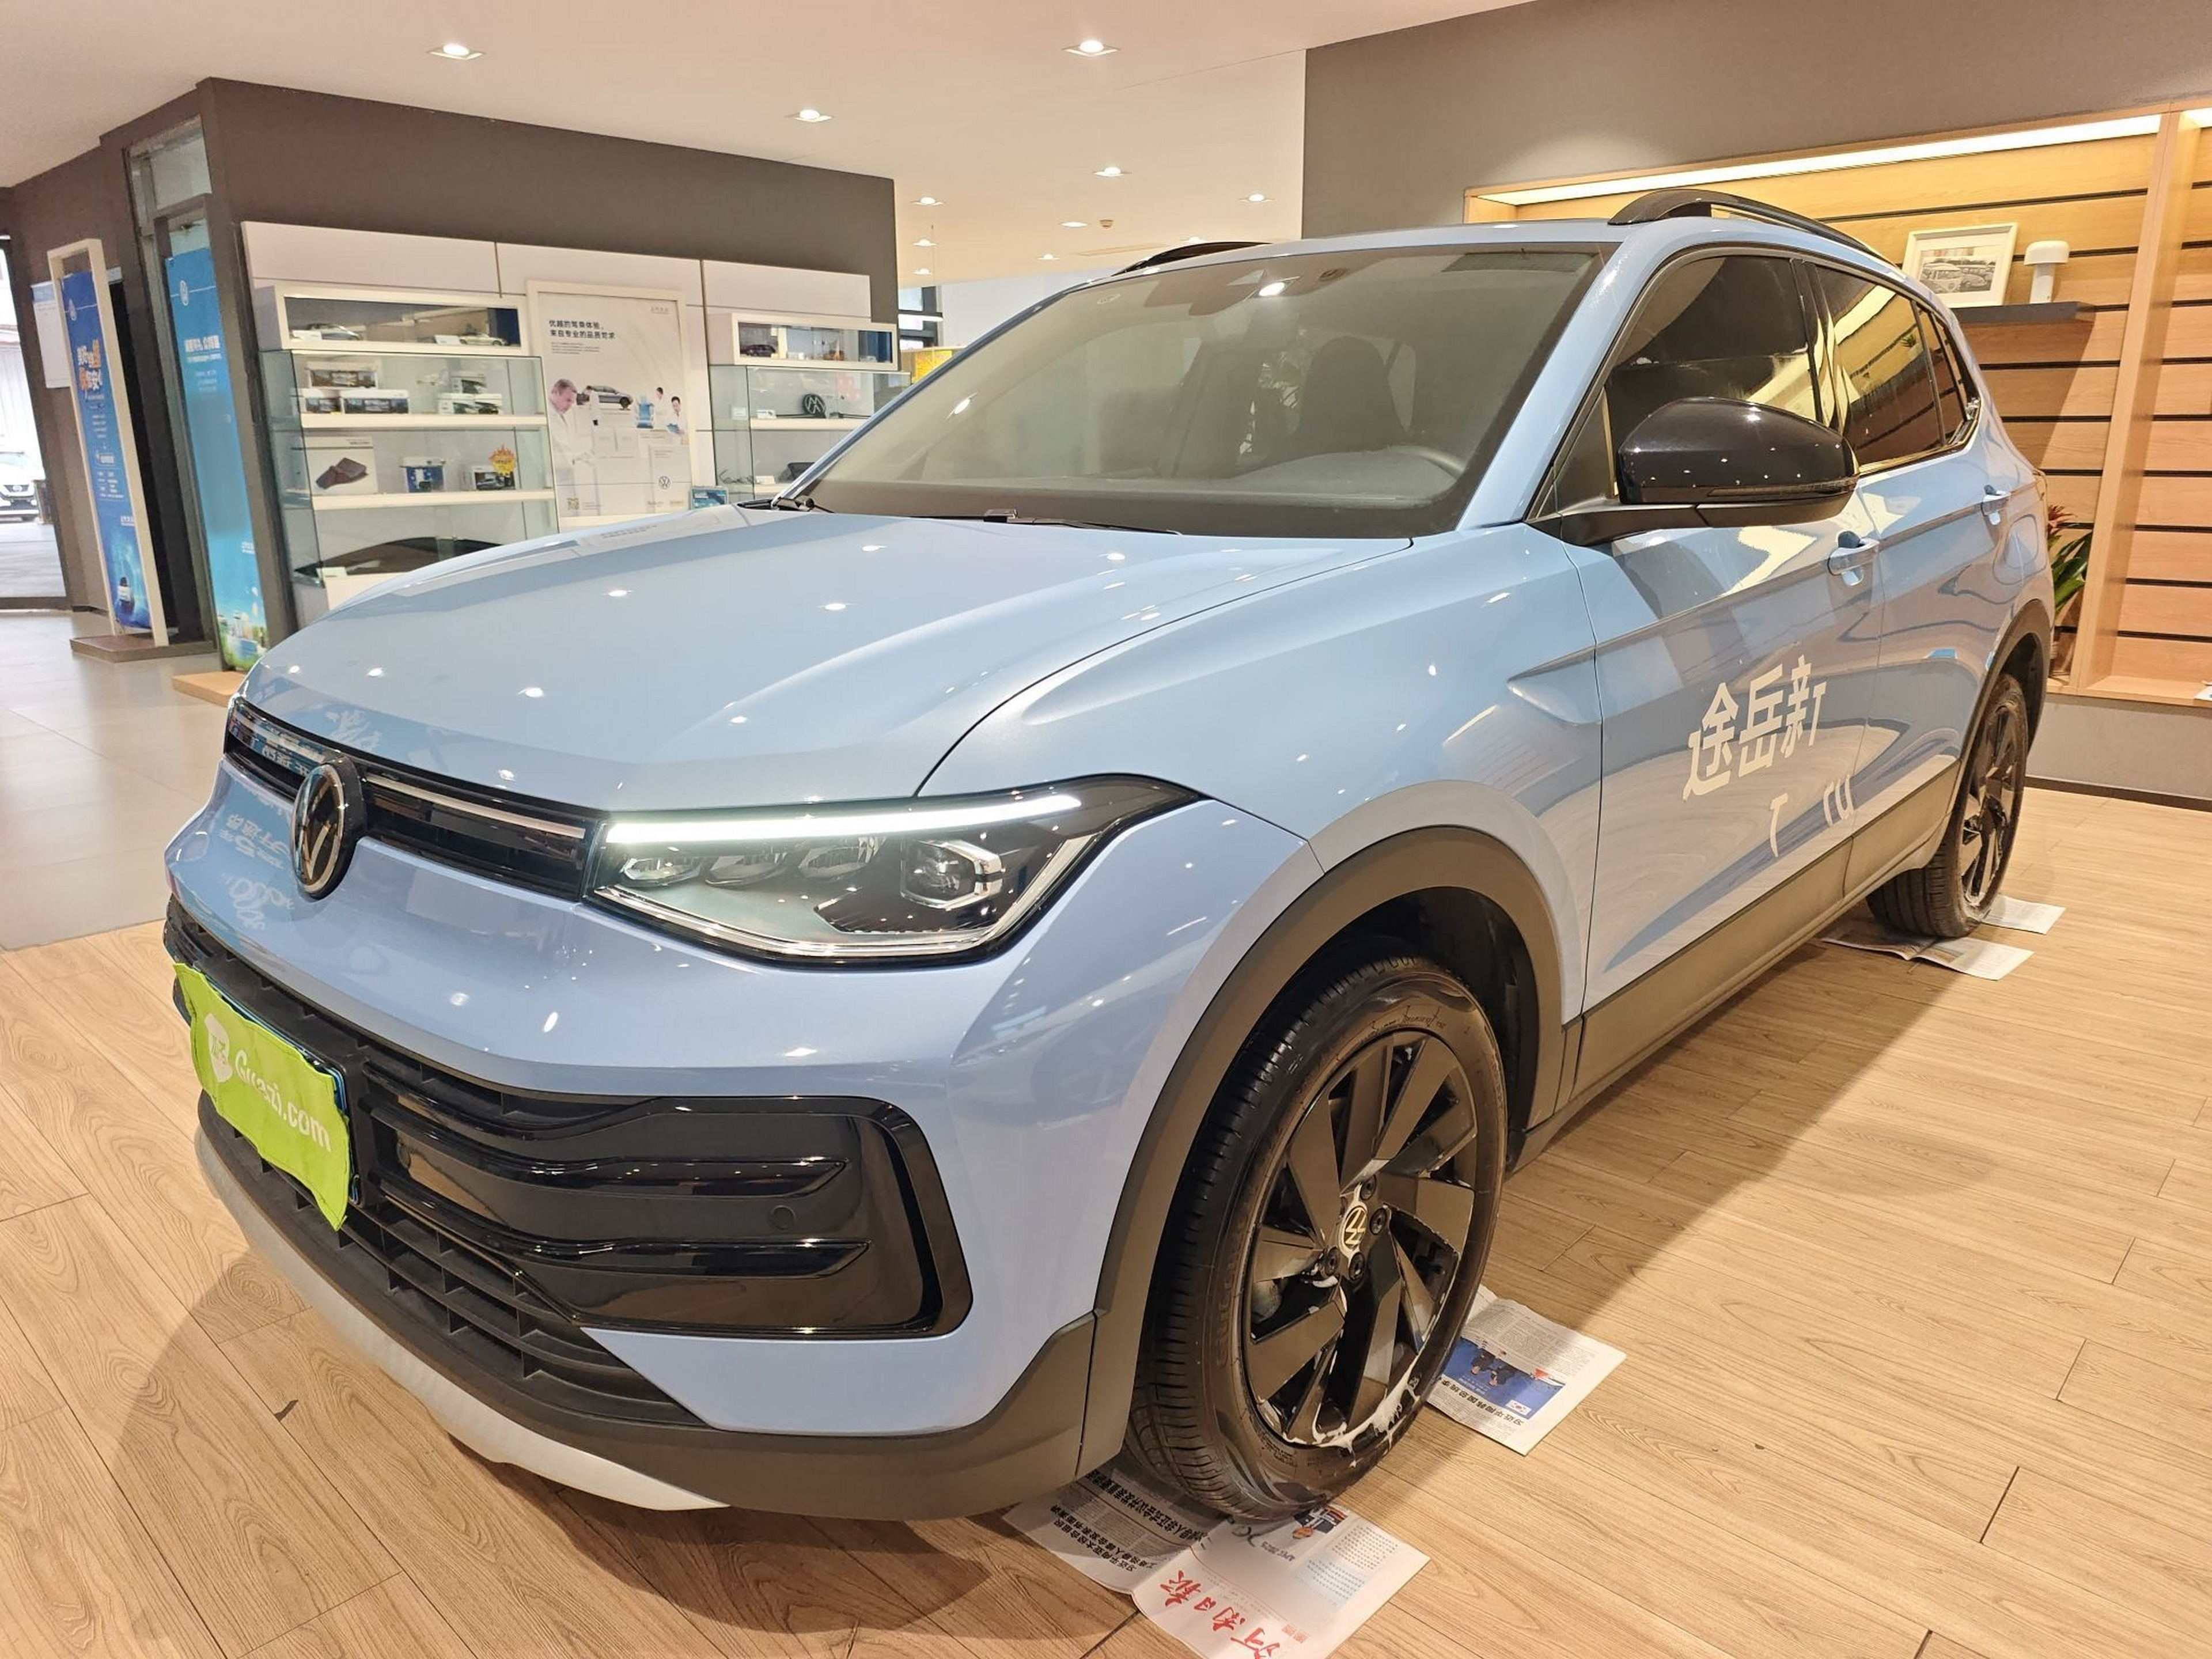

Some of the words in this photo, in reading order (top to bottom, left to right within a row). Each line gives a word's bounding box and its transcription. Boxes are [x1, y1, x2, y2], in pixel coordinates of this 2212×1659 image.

[1683, 654, 1827, 802] 途岳新
[234, 1050, 332, 1153] Guazi.com
[1160, 1570, 1281, 1659] 河南日报
